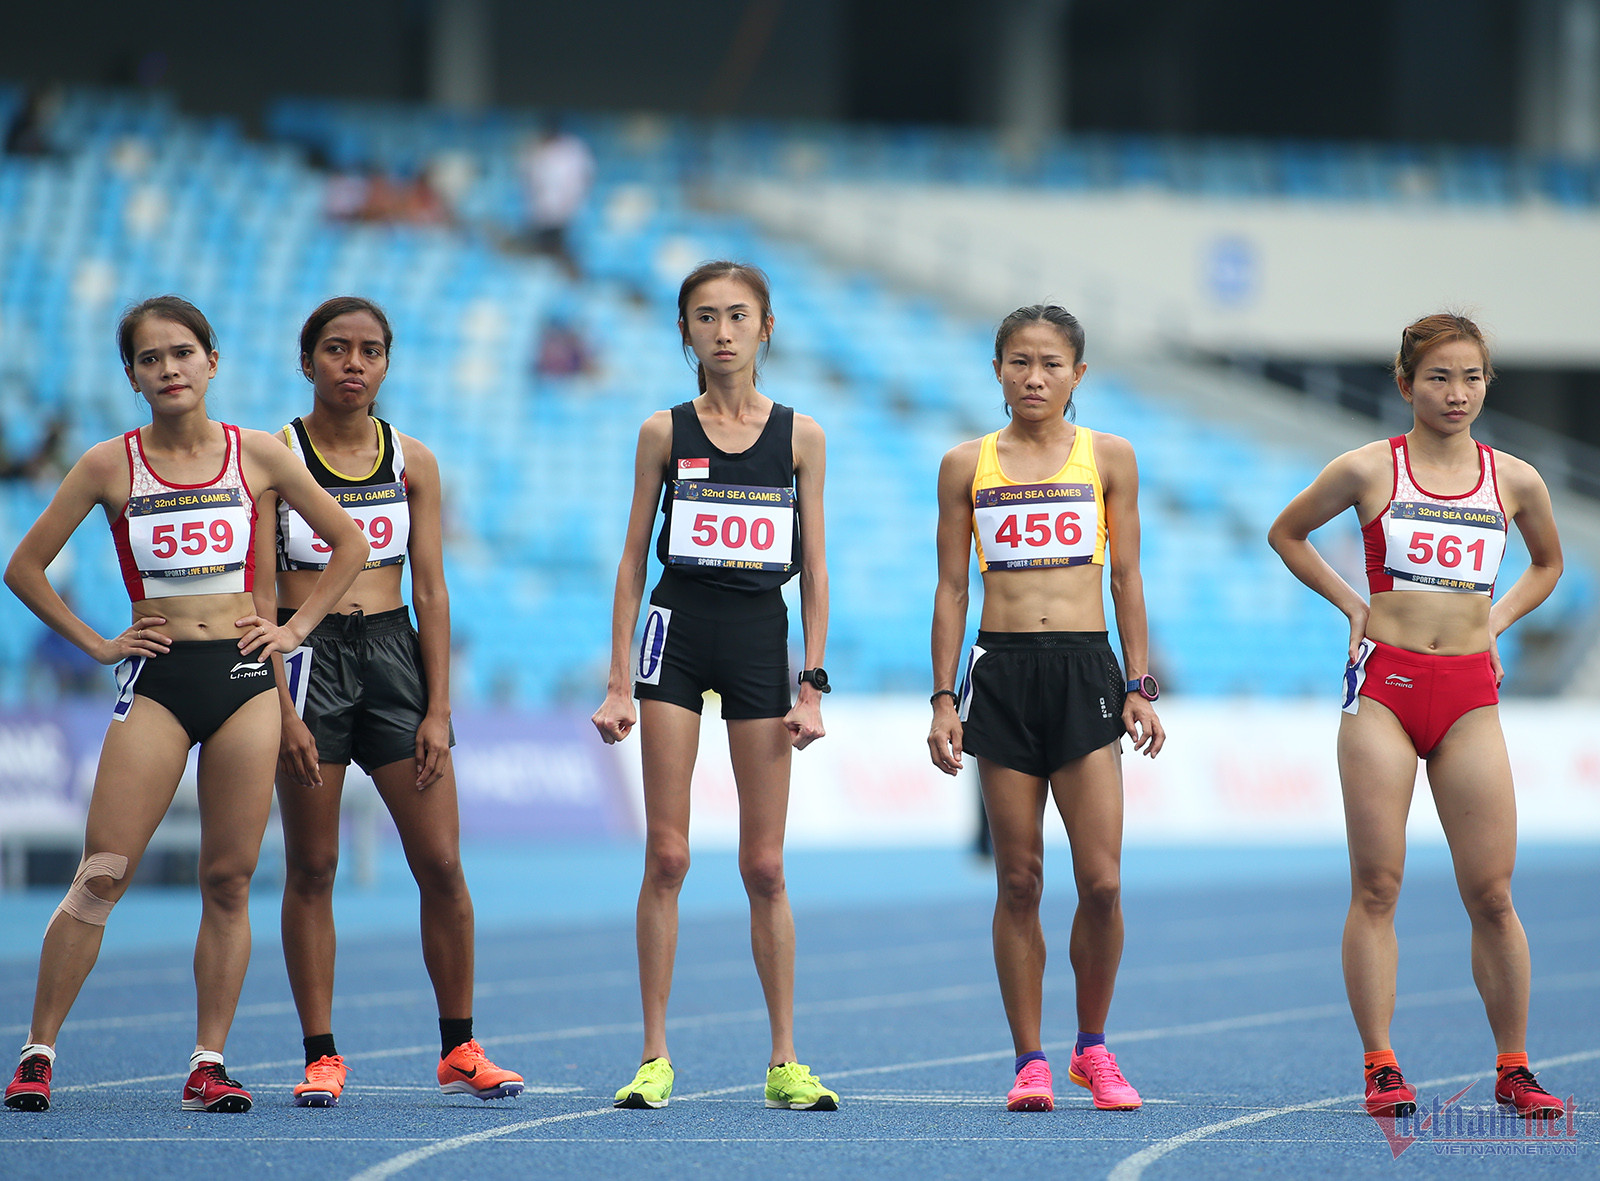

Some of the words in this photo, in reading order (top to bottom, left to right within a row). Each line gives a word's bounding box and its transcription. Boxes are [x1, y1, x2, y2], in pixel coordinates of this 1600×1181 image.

[343, 493, 363, 502] SEA
[365, 489, 396, 500] GAMES
[701, 488, 725, 498] 32nd
[727, 490, 746, 500] SEA
[748, 492, 782, 502] GAMES
[1000, 491, 1022, 500] 32nd
[1024, 490, 1044, 499] SEA
[1046, 489, 1082, 498] GAMES
[154, 498, 176, 509] 32nd
[178, 495, 199, 505] SEA
[200, 493, 232, 504] GAMES
[1418, 507, 1441, 518] 32nd
[1443, 511, 1462, 520] SEA
[1464, 512, 1497, 524] GAMES
[691, 513, 775, 551] 500
[995, 511, 1082, 548] 456
[152, 519, 234, 559] 559
[1407, 531, 1485, 571] 561
[365, 560, 381, 569] PEACE
[745, 561, 763, 569] PEACE
[1052, 557, 1069, 565] PEACE
[210, 565, 225, 573] PEACE
[1458, 581, 1475, 590] PEACE
[230, 670, 268, 680] LI-NING
[1385, 680, 1414, 689] LI-NING
